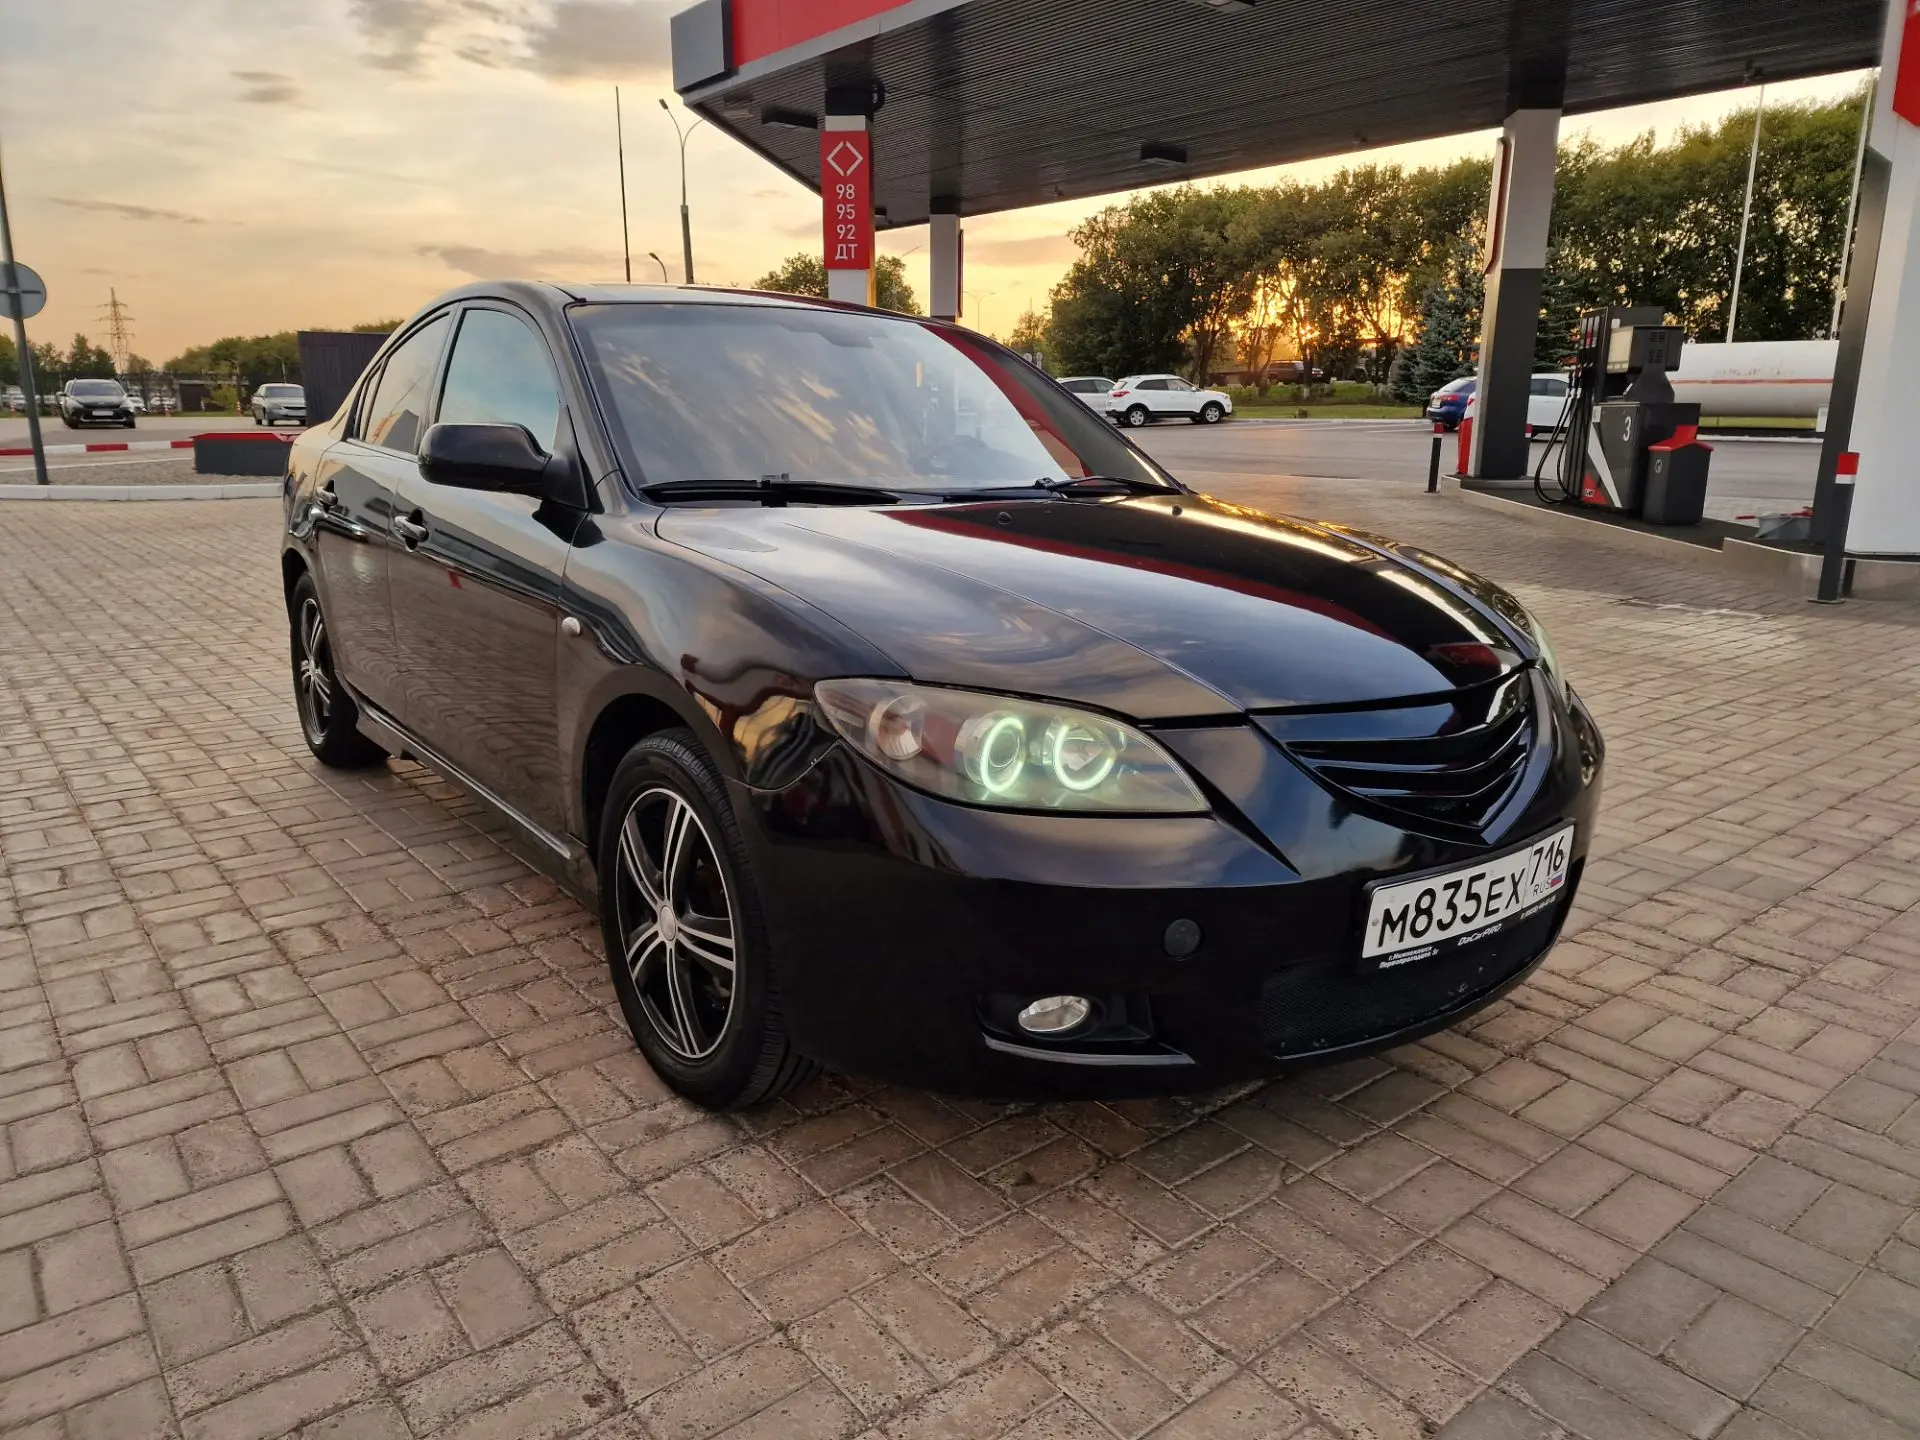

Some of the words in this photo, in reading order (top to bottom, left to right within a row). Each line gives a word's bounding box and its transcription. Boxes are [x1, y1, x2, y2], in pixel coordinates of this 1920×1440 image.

[836, 184, 855, 200] 98
[836, 204, 855, 220] 95
[836, 224, 856, 240] 92
[835, 244, 858, 260] ДТ
[1623, 416, 1632, 442] 3
[1378, 868, 1526, 948] М835ЕХ
[1531, 835, 1565, 885] 716
[1533, 877, 1550, 897] RUS
